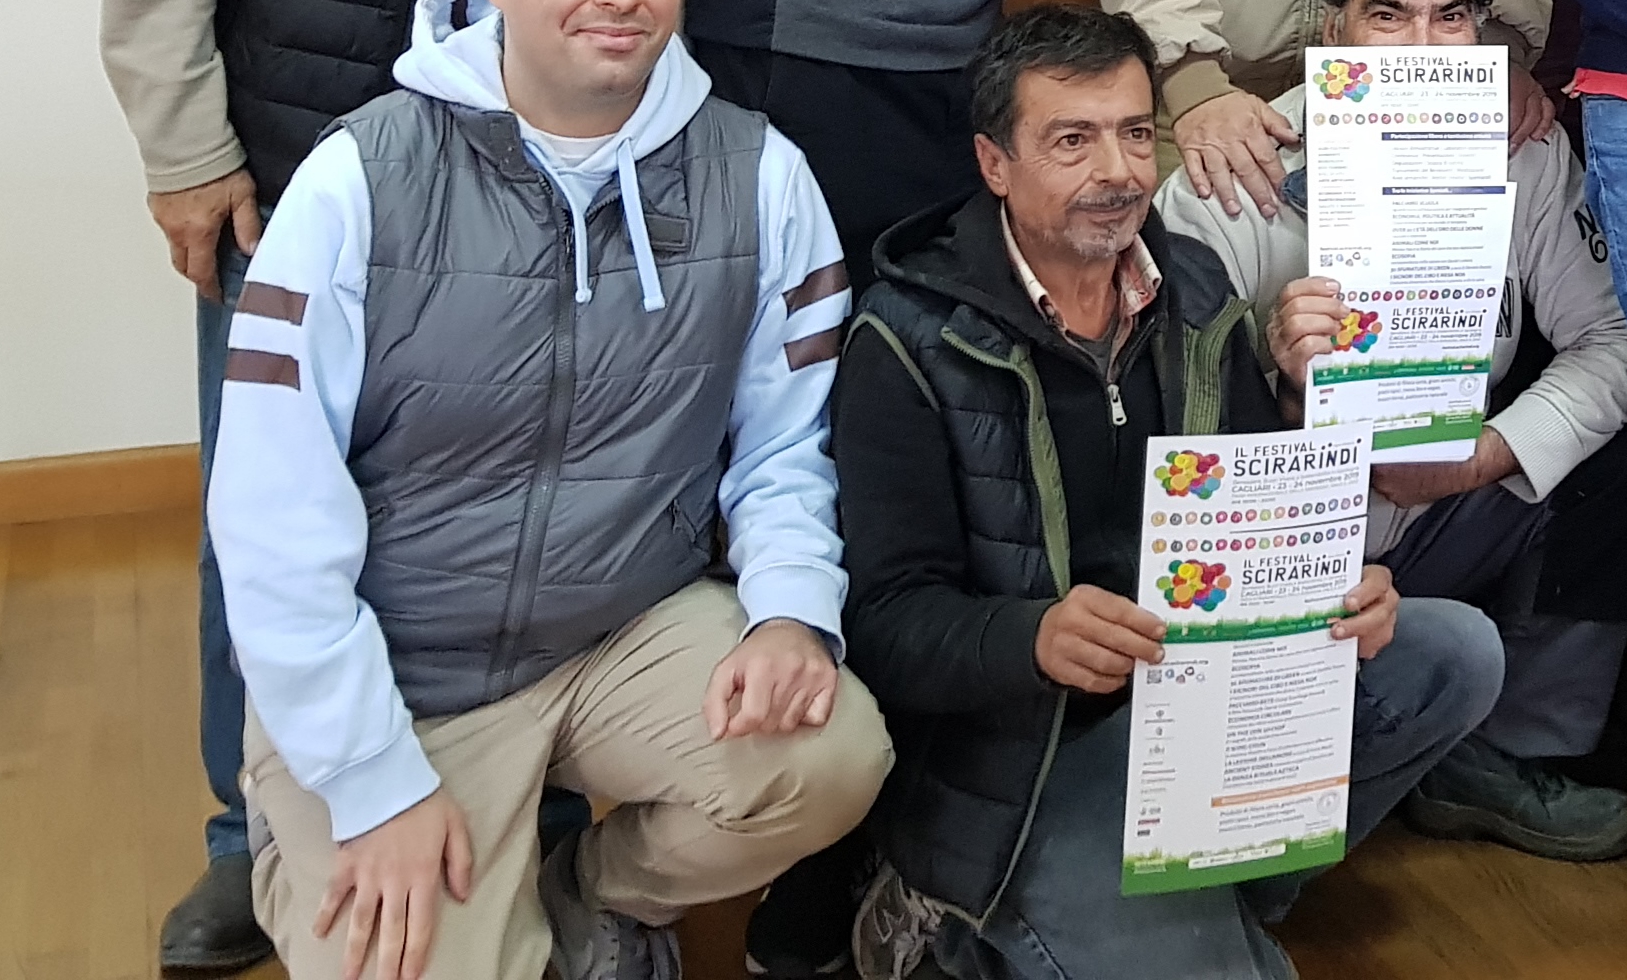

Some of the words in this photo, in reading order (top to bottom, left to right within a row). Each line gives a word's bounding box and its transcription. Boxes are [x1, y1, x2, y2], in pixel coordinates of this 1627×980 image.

[1380, 57, 1391, 66] IL
[1397, 56, 1453, 66] FESTIVAL
[1393, 308, 1402, 316] IL
[1406, 307, 1451, 316] FESTIVAL
[1235, 447, 1248, 458] IL
[1254, 441, 1316, 457] FESTIVAL
[1244, 559, 1255, 568] IL
[1260, 553, 1312, 567] FESTIVAL
